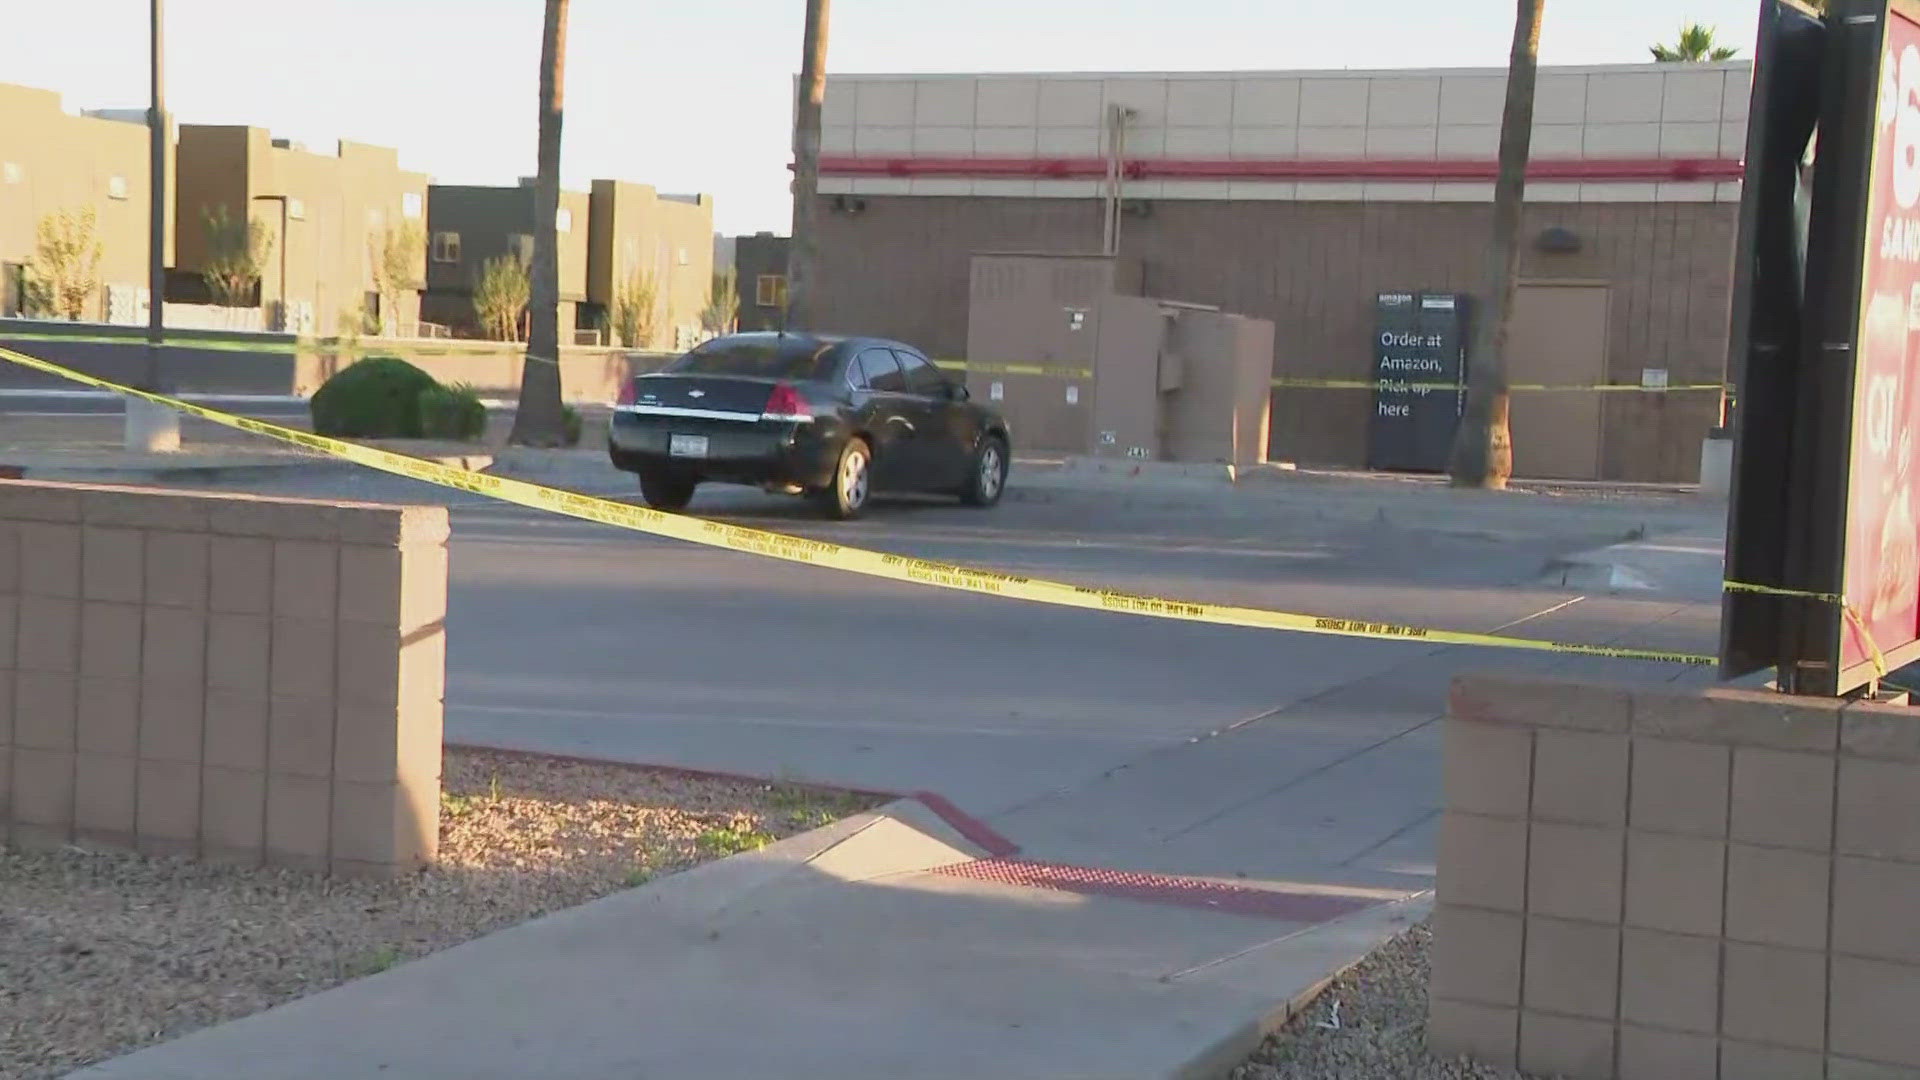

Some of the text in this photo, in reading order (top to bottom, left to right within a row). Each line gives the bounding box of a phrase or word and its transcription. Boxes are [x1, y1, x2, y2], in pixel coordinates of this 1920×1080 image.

[1379, 294, 1412, 305] amazon
[1381, 331, 1442, 347] Order at
[1380, 355, 1442, 373] Amazon,
[1379, 378, 1431, 397] Pick up
[1378, 401, 1410, 416] here
[1314, 618, 1427, 637] FIRE LINE DO NOT CROSS
